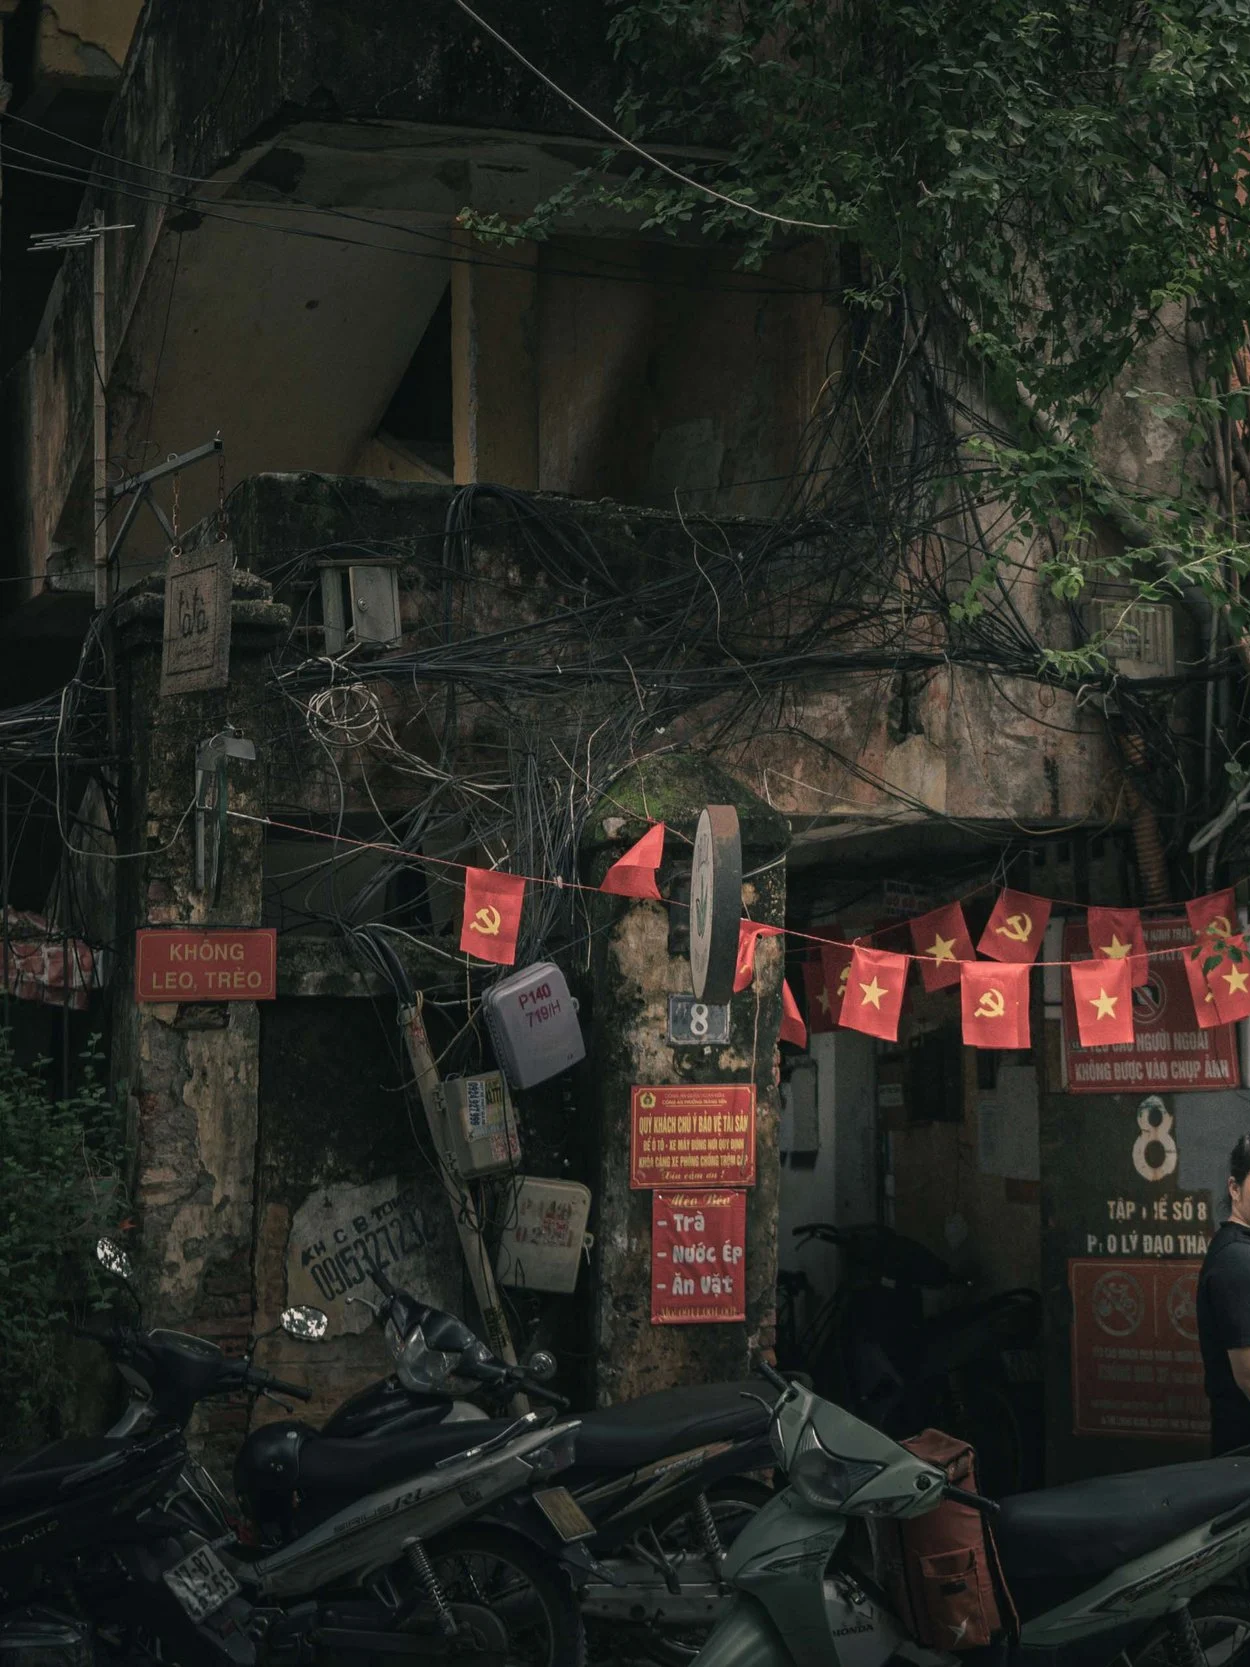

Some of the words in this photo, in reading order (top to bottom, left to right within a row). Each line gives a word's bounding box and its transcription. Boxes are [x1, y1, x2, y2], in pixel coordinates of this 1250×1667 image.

[169, 939, 245, 961] KHÔNG
[152, 971, 198, 992] LEO,
[204, 967, 262, 989] TRÈO
[518, 983, 551, 1010] P140
[525, 999, 561, 1028] 719/H
[690, 1003, 709, 1036] 8
[653, 1113, 677, 1134] KHÁCH
[1132, 1095, 1177, 1181] 8
[673, 1210, 705, 1232] Trà
[1107, 1196, 1136, 1223] TẬP
[1197, 1202, 1207, 1221] 8
[672, 1242, 716, 1263] Nước
[722, 1240, 743, 1265] Ép
[1177, 1230, 1212, 1255] THÀ
[672, 1272, 694, 1295] Ăn
[700, 1272, 734, 1298] Vặt
